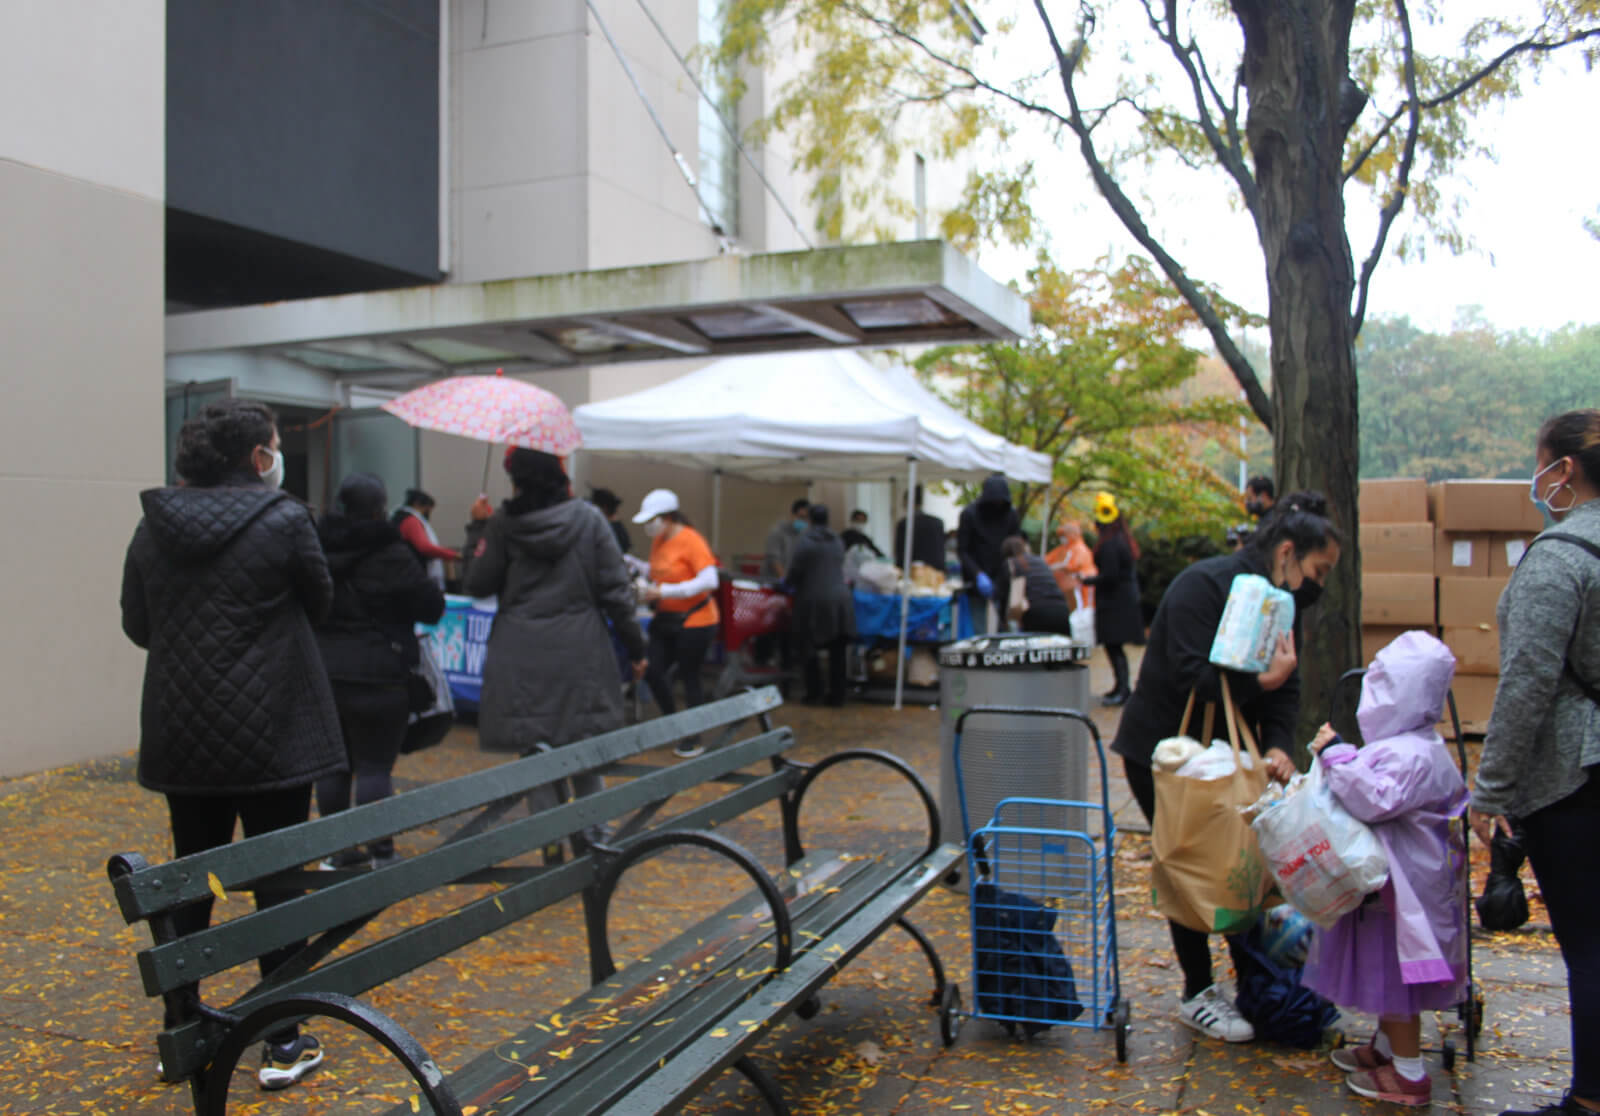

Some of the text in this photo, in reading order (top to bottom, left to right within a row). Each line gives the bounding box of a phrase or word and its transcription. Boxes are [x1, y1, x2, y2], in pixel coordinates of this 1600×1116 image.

[983, 651, 1026, 666] DON'T
[1029, 648, 1073, 664] LITTER
[1306, 839, 1331, 857] YOU
